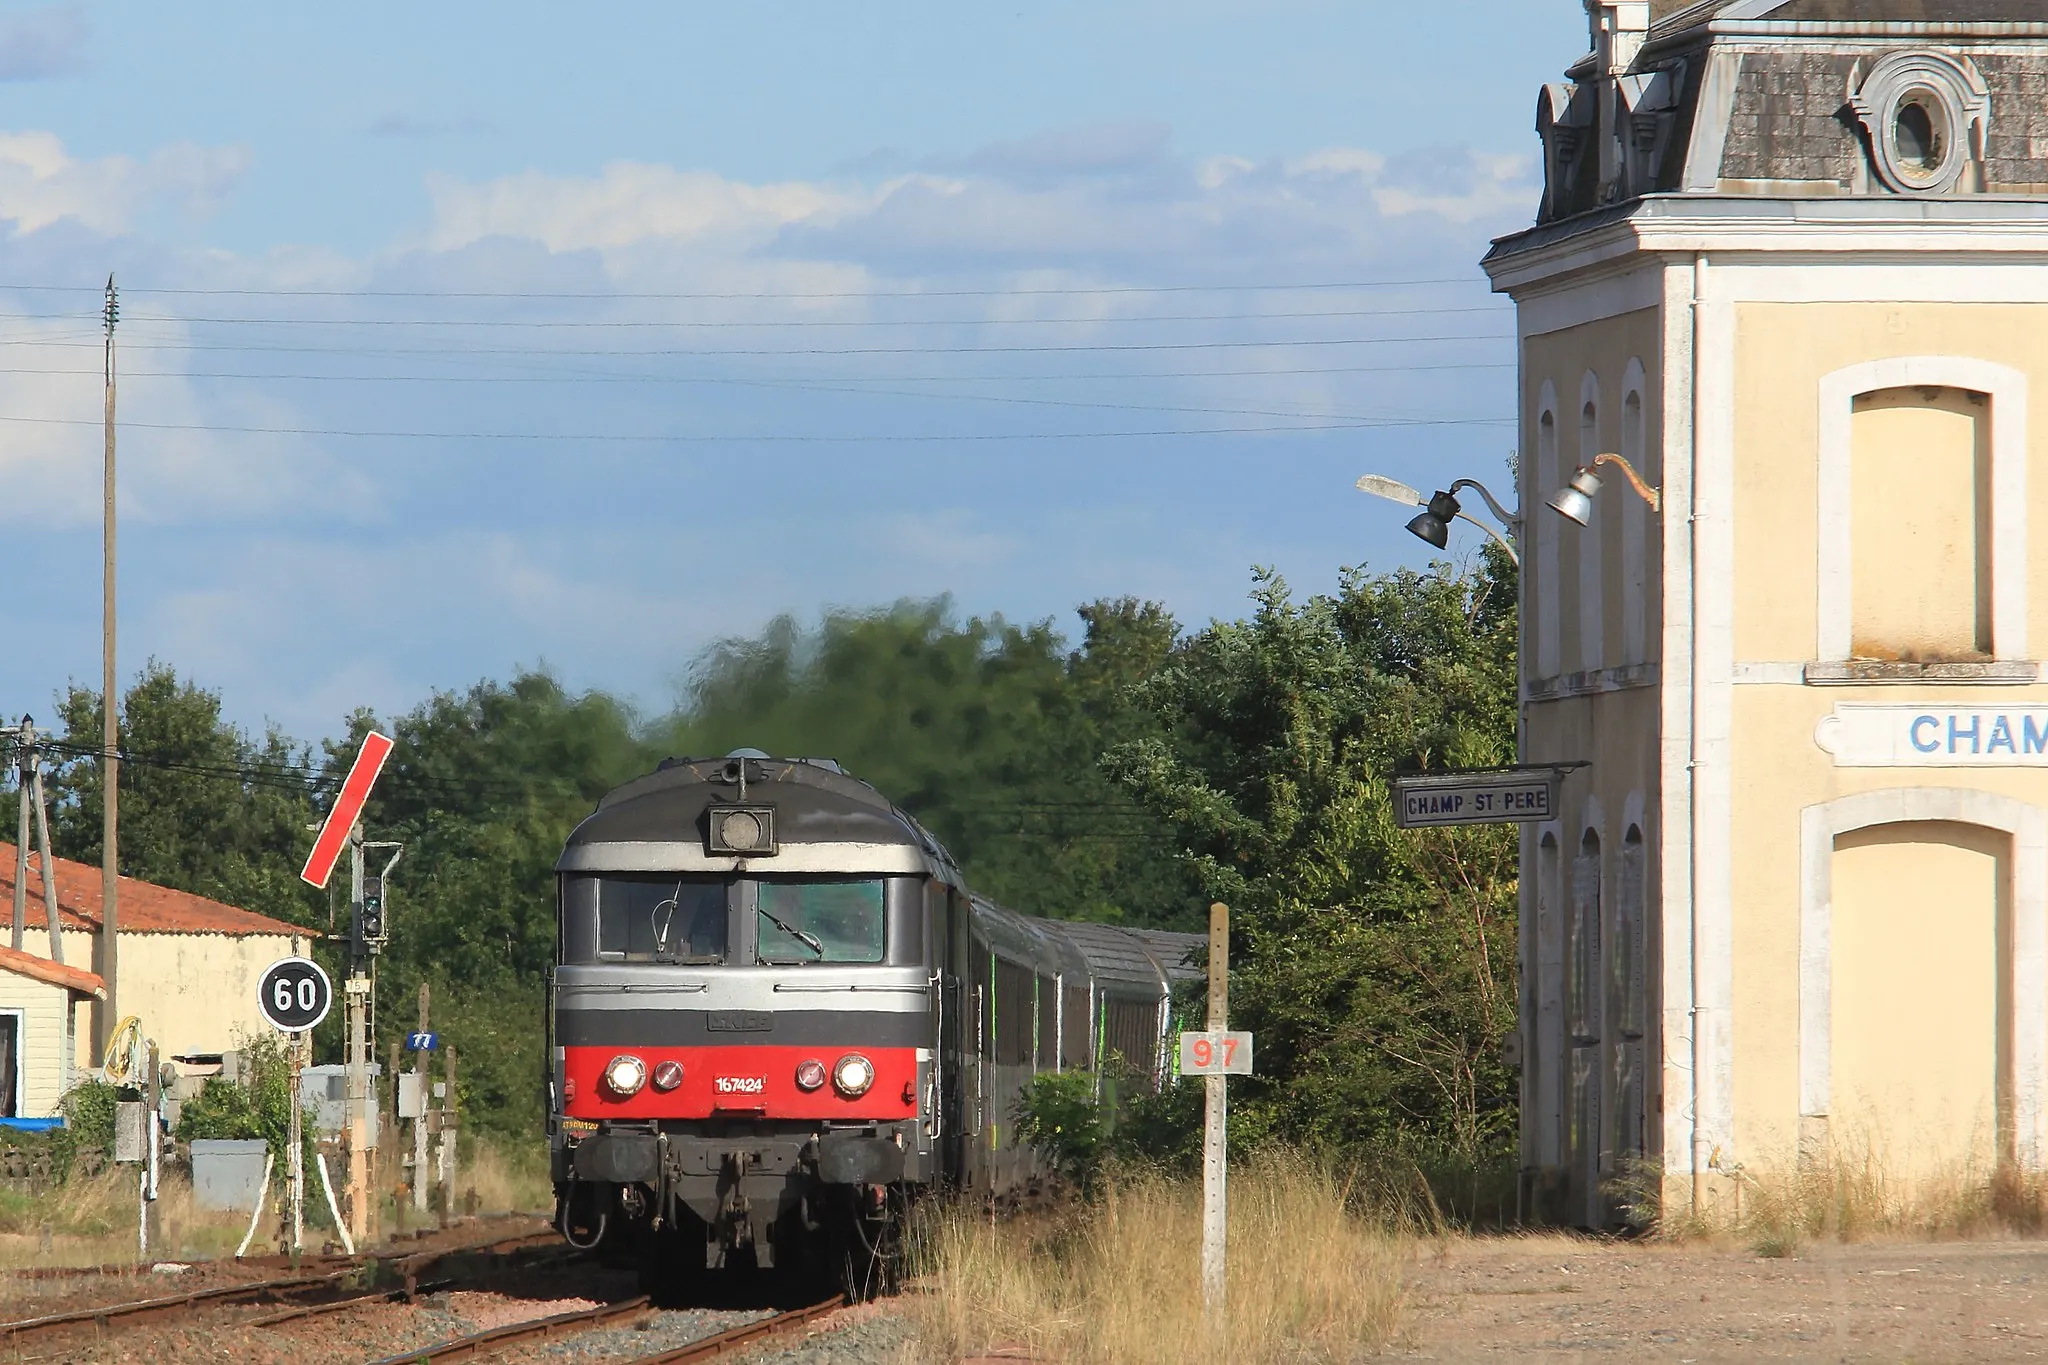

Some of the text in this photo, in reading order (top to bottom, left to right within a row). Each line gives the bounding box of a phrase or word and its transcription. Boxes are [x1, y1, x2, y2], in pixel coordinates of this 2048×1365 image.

[274, 978, 316, 1011] 60
[1193, 1039, 1239, 1068] 97
[715, 1077, 763, 1093] 167424
